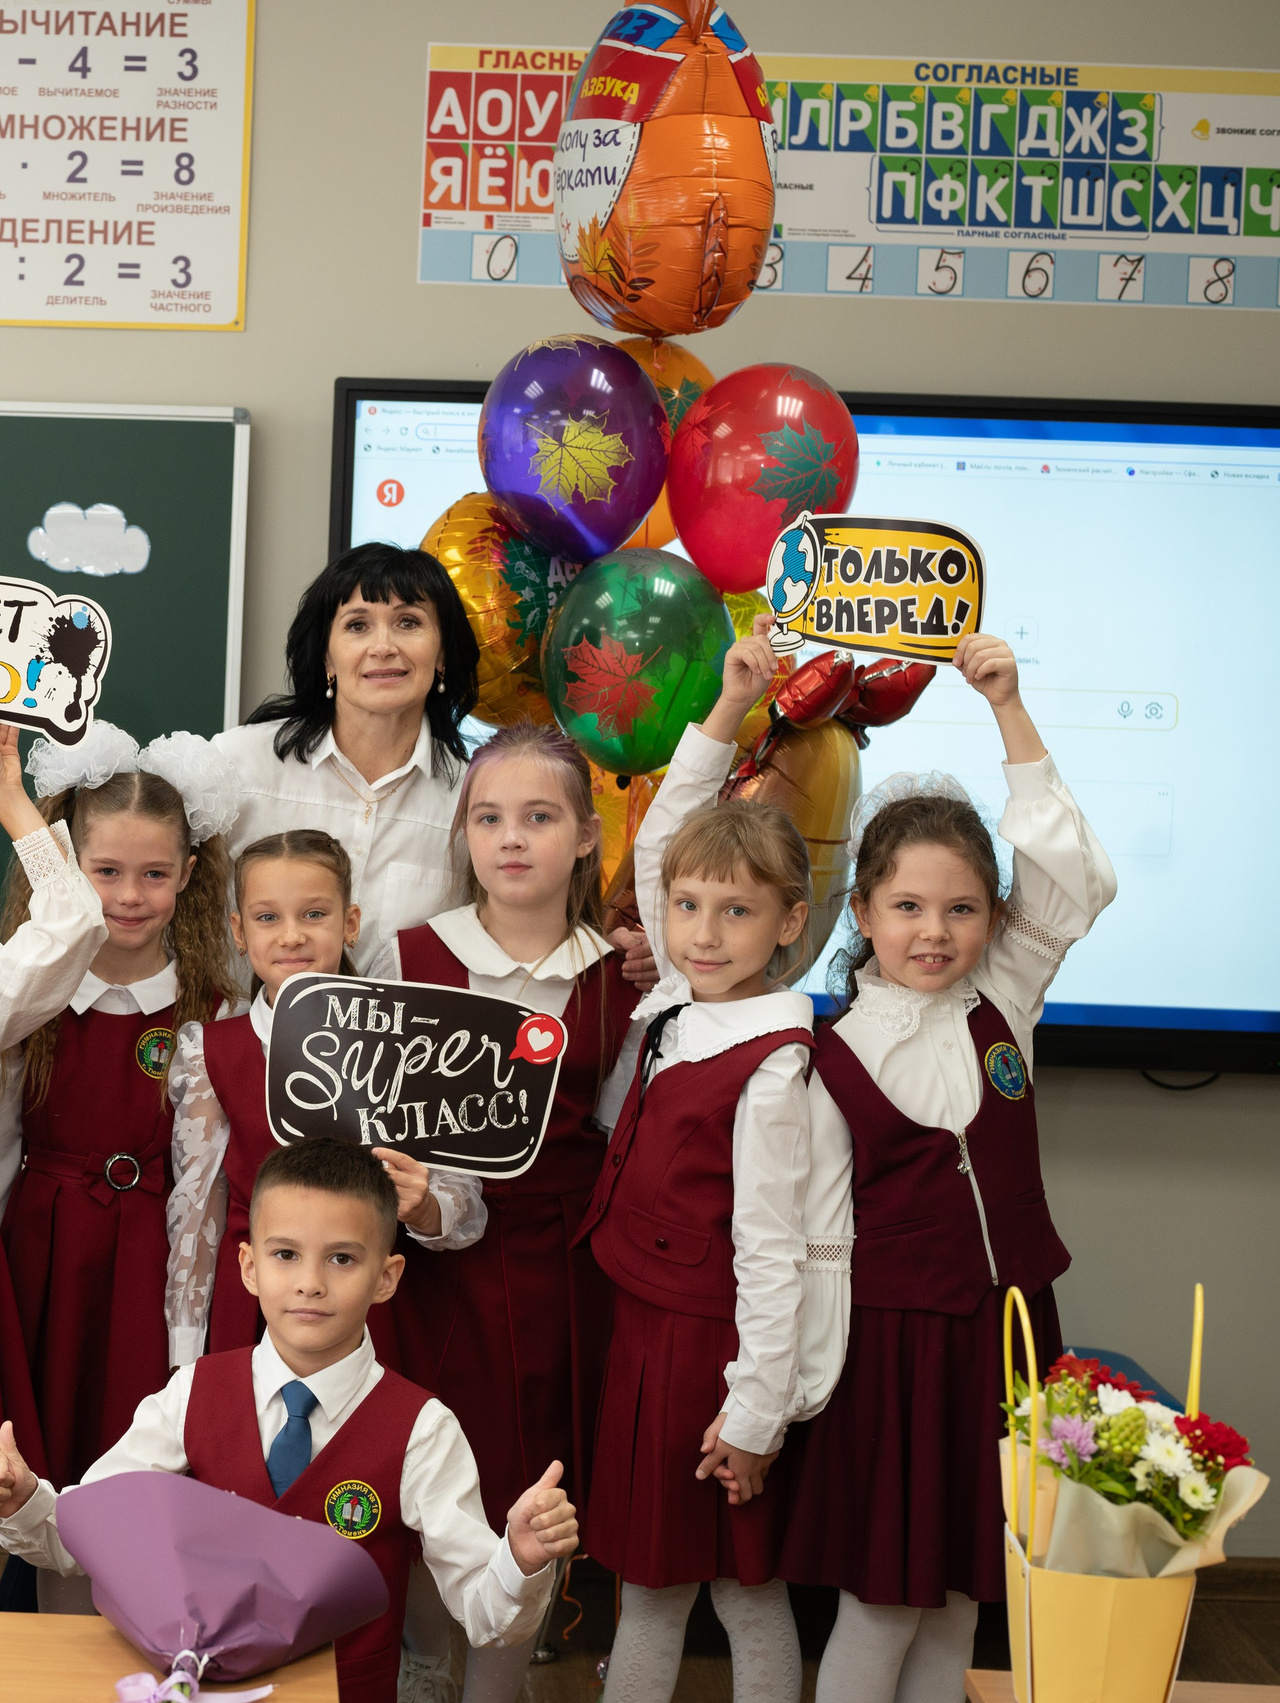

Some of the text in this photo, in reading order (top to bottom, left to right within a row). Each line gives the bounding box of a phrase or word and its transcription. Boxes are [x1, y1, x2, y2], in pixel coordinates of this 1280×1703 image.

[68, 46, 92, 79] 4
[176, 48, 199, 81] 3
[477, 49, 588, 71] ГЛАСНЫ
[914, 62, 1079, 87] СОГЛАСНЫЕ
[38, 86, 120, 99] ВЫЧИТАЕМОЕ
[156, 87, 218, 98] ЗНАЧЕНИЕ
[580, 76, 640, 105] АЗБУКА
[156, 99, 218, 111] РАЗНОСТИ
[592, 128, 623, 148] за
[1215, 127, 1257, 136] ЗВОНКИЕ
[65, 151, 89, 183] 2
[173, 152, 196, 186] 8
[42, 191, 117, 203] МНОЖИТЕЛЬ
[153, 190, 214, 203] ЗНАЧЕНИЕ
[776, 182, 815, 192] ЛАСНЫЕ
[136, 203, 231, 216] ПРОИЗВЕДЕНИЯ
[956, 229, 1068, 241] ПАРНЫЕ СОГЛАСНЫЕ
[63, 254, 86, 286] 2
[170, 256, 193, 289] 3
[845, 246, 874, 293] 4
[927, 248, 966, 295] 5
[1022, 251, 1056, 298] 6
[1113, 254, 1146, 301] 7
[1203, 257, 1236, 304] 8
[45, 295, 108, 307] ДЕЛИТЕЛЬ
[150, 287, 211, 301] ЗНАЧЕНИЕ
[149, 302, 212, 314] ЧАСТНОГО
[822, 545, 968, 587] ТОЛЬКО
[814, 594, 972, 638] ВПЕРЕД!
[284, 1029, 516, 1121] Super
[355, 1088, 530, 1146] КЛАСС!
[328, 1483, 379, 1514] ГИМНАЗИЯ № 16
